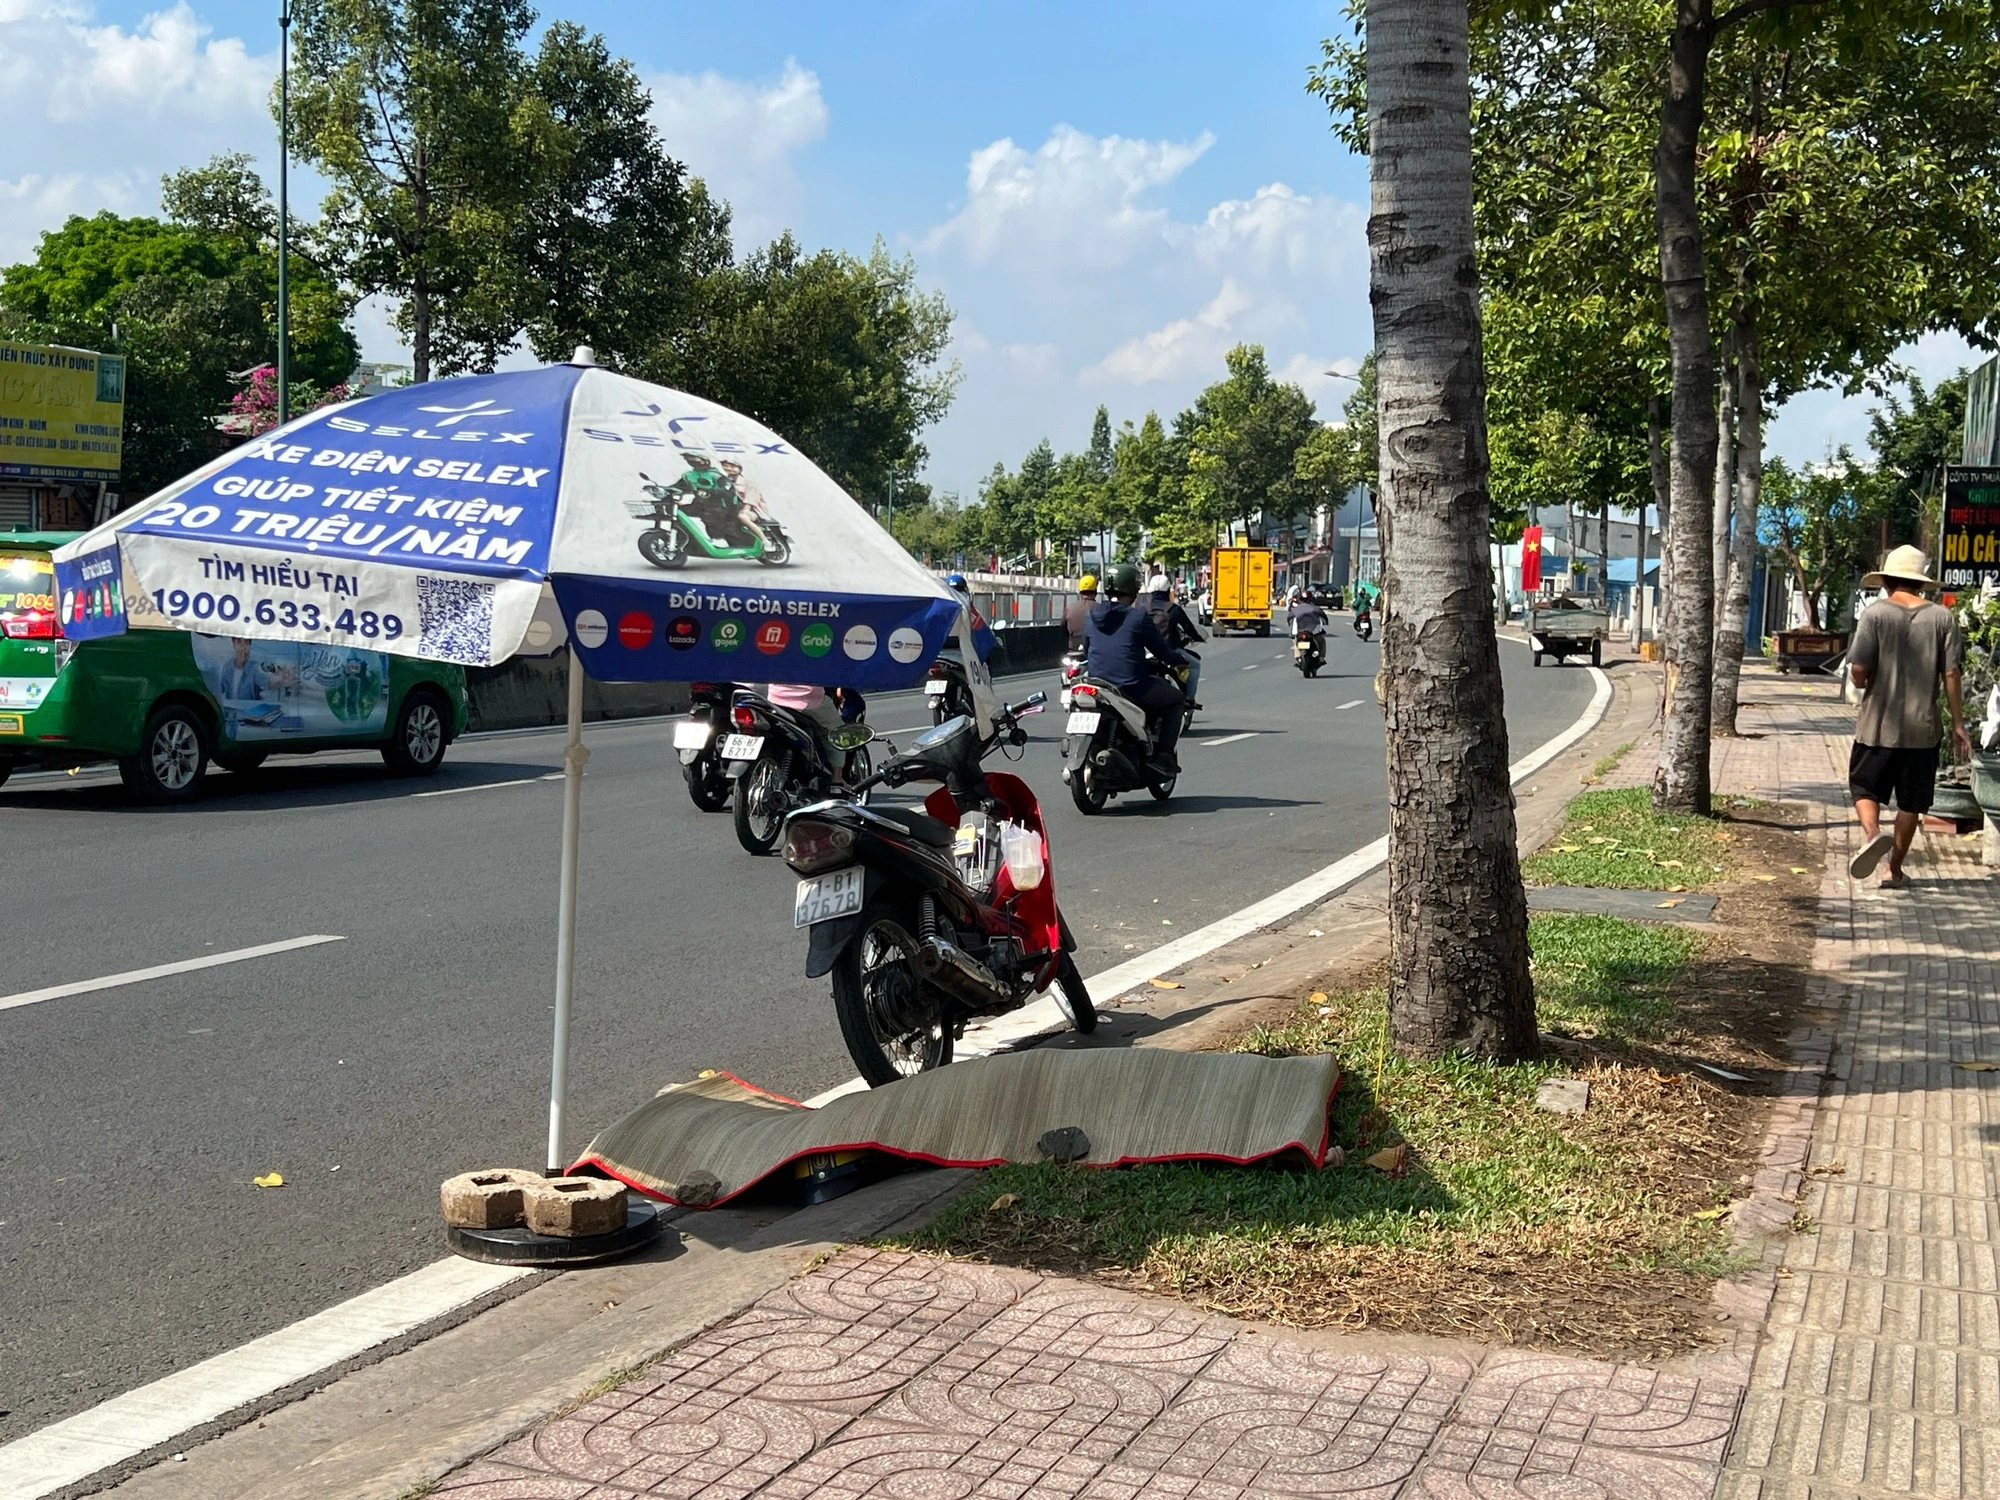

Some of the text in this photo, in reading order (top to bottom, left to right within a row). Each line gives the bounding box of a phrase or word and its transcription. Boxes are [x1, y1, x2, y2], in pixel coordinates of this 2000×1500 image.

[326, 416, 536, 445] SELEX
[583, 428, 791, 456] SELEX
[247, 441, 551, 489] XE ĐIỆN SELEX
[212, 475, 525, 528] GIÚP TIẾT KIỆM
[142, 501, 534, 566] 20 TRIỆU/NĂM
[1945, 525, 1994, 562] HỒ CÁ
[199, 554, 360, 602] TÌM HIỂU TẠI
[152, 587, 404, 641] 1900.633.489
[669, 590, 842, 618] ĐỐI TÁC CỦA SELEX
[714, 638, 739, 648] gojek
[802, 634, 832, 647] Grab
